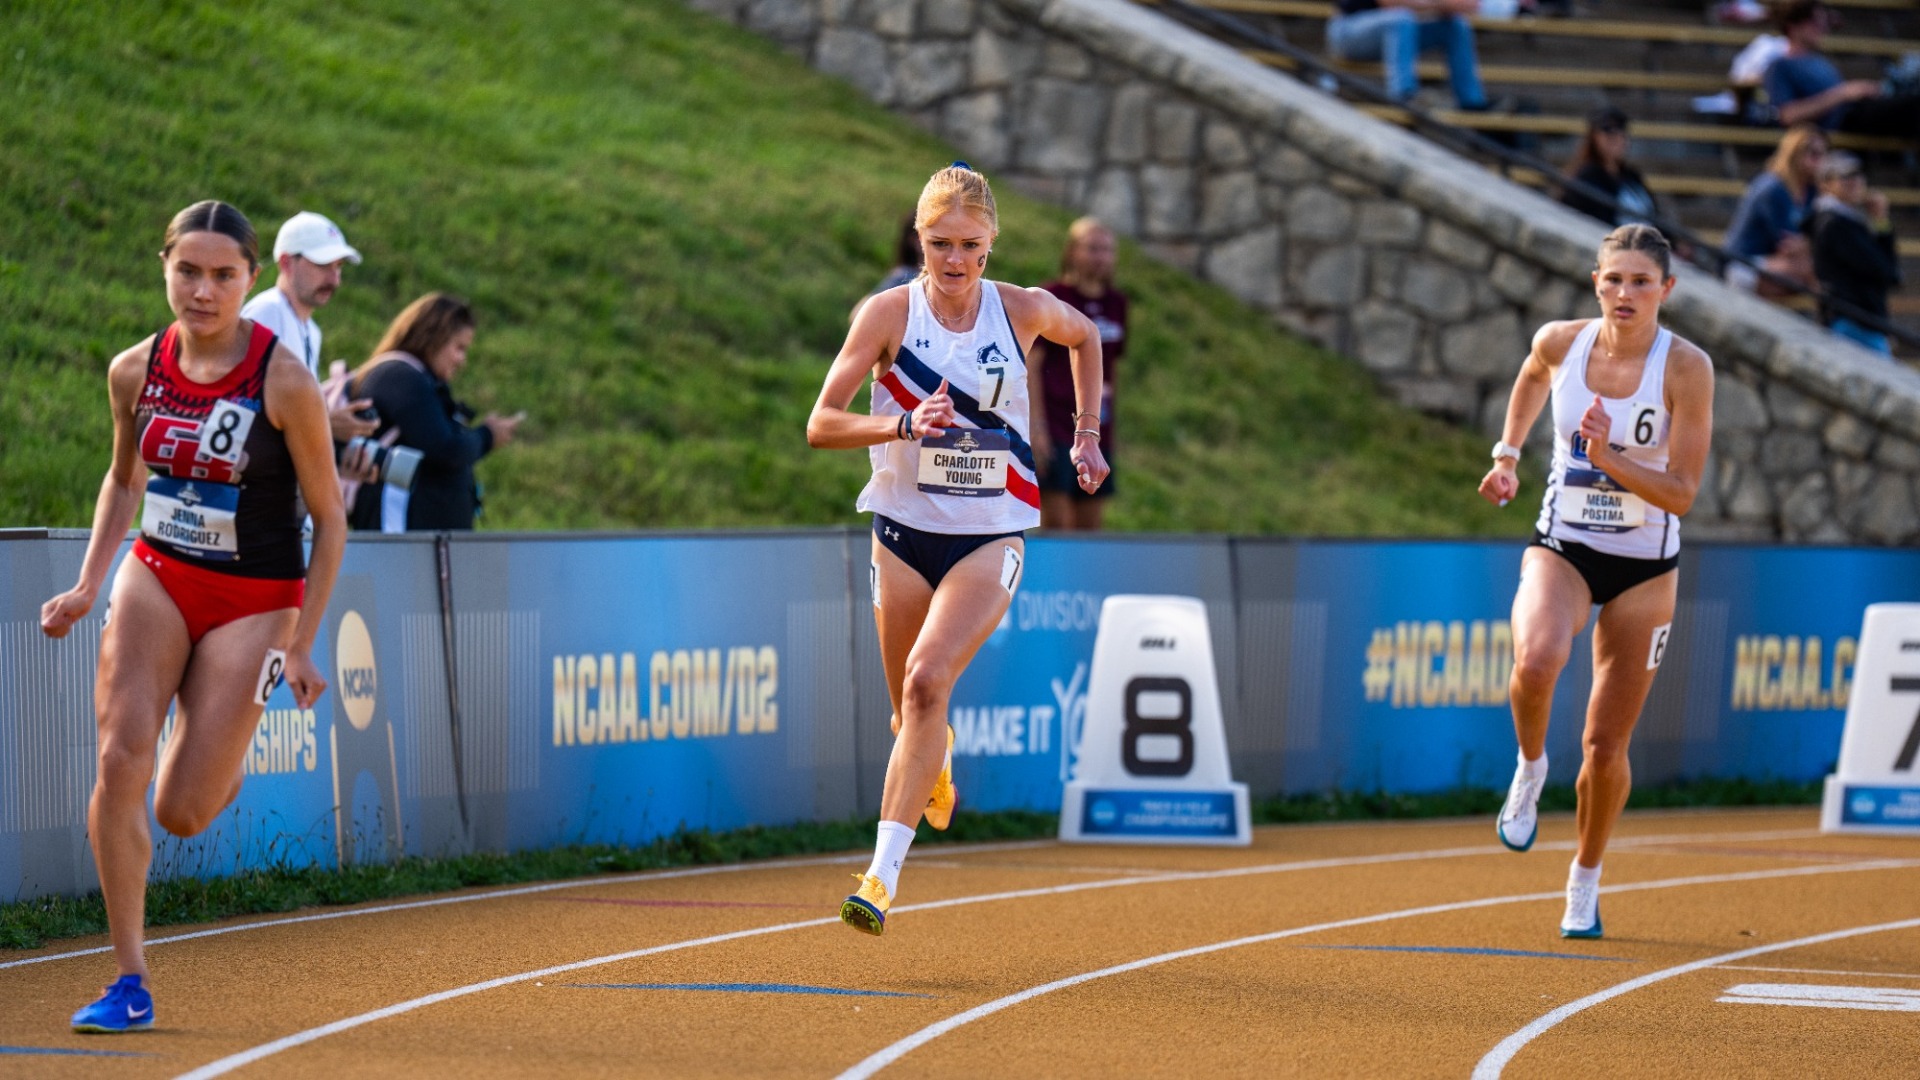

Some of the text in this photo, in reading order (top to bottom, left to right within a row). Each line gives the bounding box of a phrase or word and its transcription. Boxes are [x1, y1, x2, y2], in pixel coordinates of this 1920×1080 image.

[986, 367, 1005, 408] 7
[210, 410, 240, 454] 8
[1634, 408, 1656, 445] 6
[934, 454, 996, 469] CHARLOTTE
[946, 471, 982, 485] YOUNG
[171, 508, 206, 528] JENNA
[1582, 508, 1625, 522] POSTMA
[1586, 493, 1622, 507] MEGAN
[157, 521, 221, 546] RODRIGUEZ
[1363, 620, 1512, 709] #NCAAD
[1654, 629, 1667, 664] 6
[342, 667, 375, 699] NCAA
[1731, 634, 1857, 711] NCAA.C
[553, 646, 778, 747] NCAA.COM/D2
[953, 705, 1025, 757] MAKE
[1028, 704, 1055, 754] IT
[1122, 674, 1195, 778] 8
